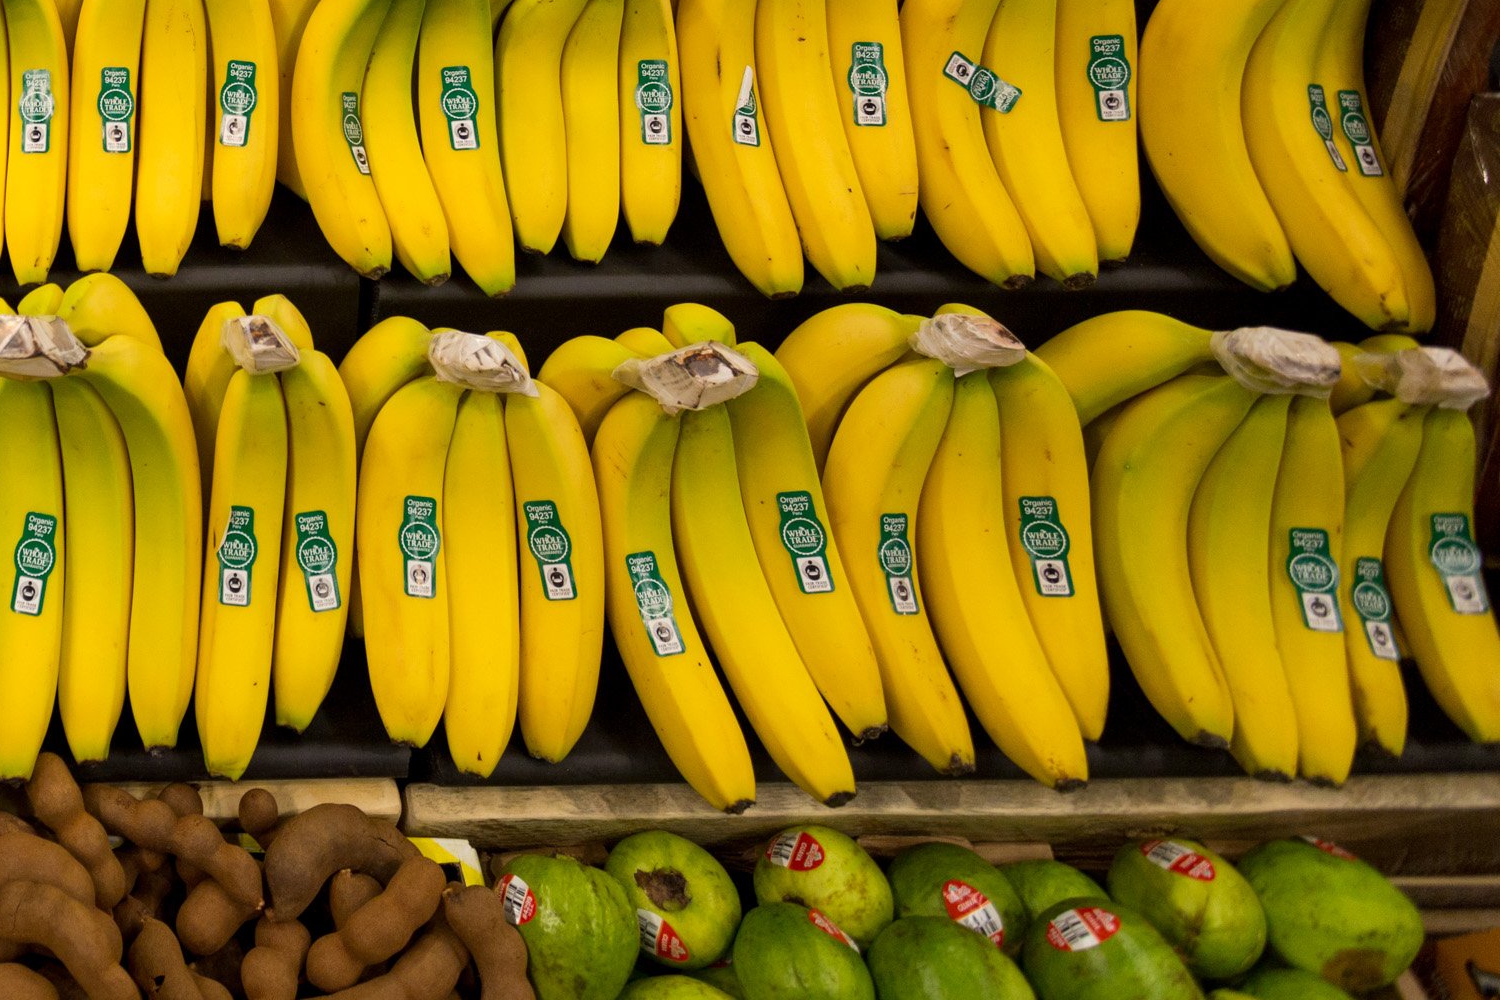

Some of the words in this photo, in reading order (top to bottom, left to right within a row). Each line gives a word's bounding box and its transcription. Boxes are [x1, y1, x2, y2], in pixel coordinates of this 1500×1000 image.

[1093, 38, 1120, 46] Organic
[1094, 44, 1120, 52] 94237
[230, 63, 253, 71] Organic
[1094, 66, 1122, 74] WHOLE
[104, 70, 127, 78] Organic
[230, 69, 252, 78] 94237
[443, 69, 467, 77] Organic
[1096, 72, 1122, 80] TRADE
[104, 76, 127, 84] 94237
[227, 90, 251, 99] WHOLE
[103, 97, 128, 105] WHOLE
[445, 97, 470, 105] WHOLE
[407, 499, 432, 508] Organic
[779, 495, 808, 504] Organic
[1022, 500, 1052, 508] Organic
[407, 506, 432, 516] 94237
[526, 504, 552, 513] Organic
[782, 502, 809, 512] 94237
[1024, 507, 1053, 515] 94237
[28, 515, 54, 526] Organic
[298, 515, 324, 524] Organic
[529, 511, 553, 521] 94237
[28, 523, 53, 534] 94237
[300, 522, 324, 532] 94237
[405, 530, 433, 540] WHOLE
[787, 527, 815, 537] WHOLE
[1027, 531, 1059, 541] WHOLE
[407, 538, 431, 548] TRADE
[534, 535, 562, 545] WHOLE
[789, 535, 817, 544] TRADE
[1030, 539, 1060, 547] TRADE
[302, 546, 329, 556] WHOLE
[535, 542, 562, 551] TRADE
[22, 548, 49, 559] WHOLE
[304, 553, 329, 562] TRADE
[22, 556, 47, 566] TRADE
